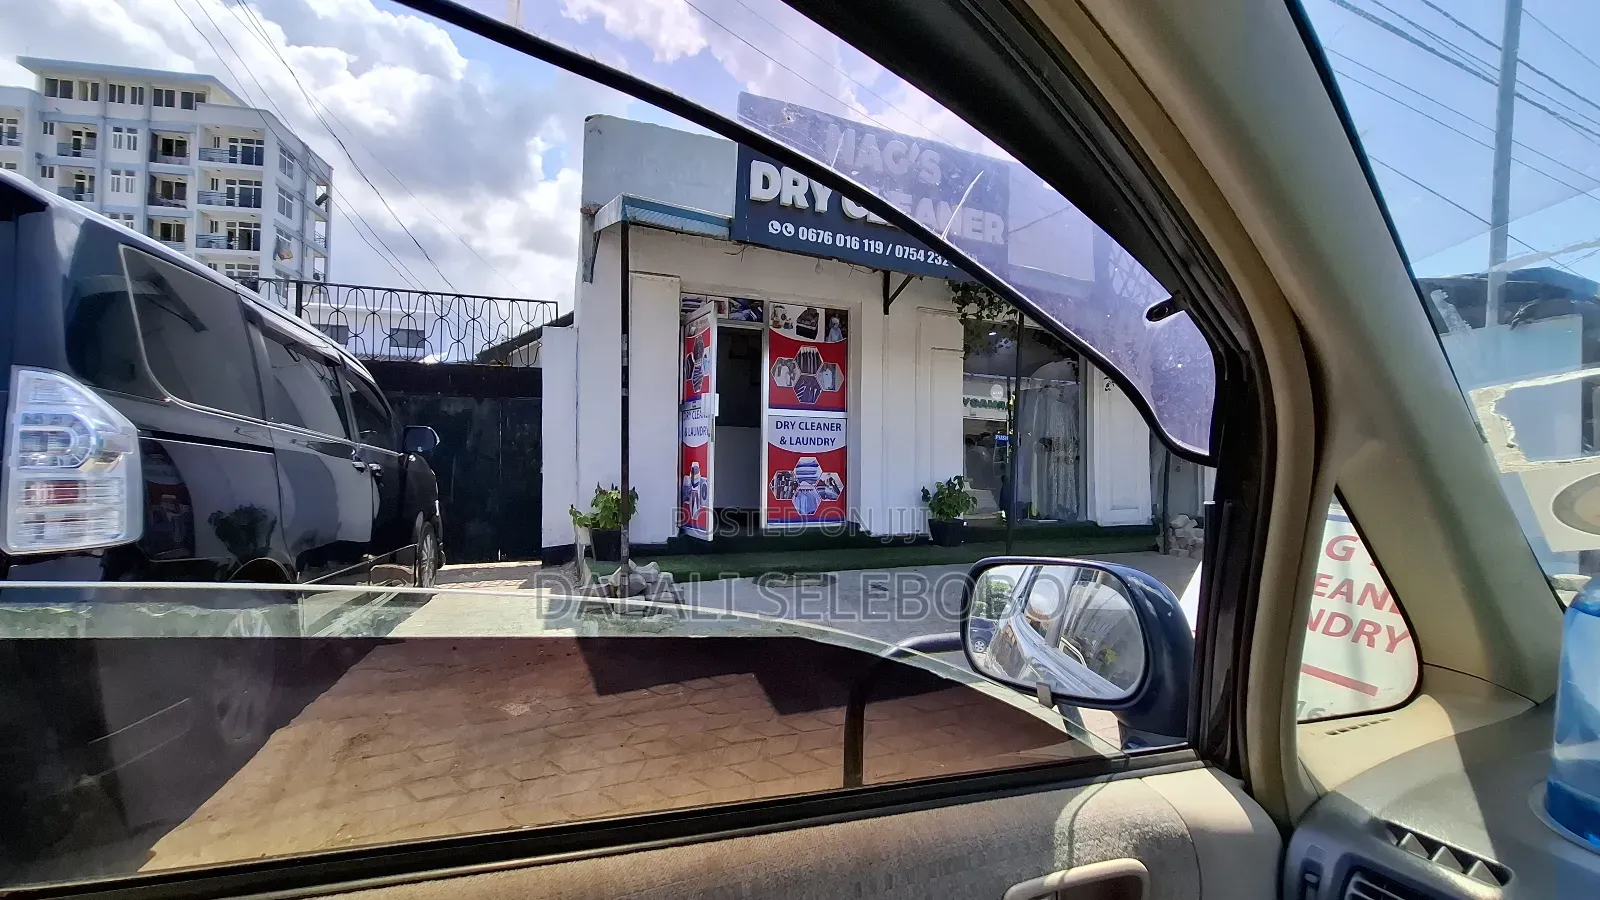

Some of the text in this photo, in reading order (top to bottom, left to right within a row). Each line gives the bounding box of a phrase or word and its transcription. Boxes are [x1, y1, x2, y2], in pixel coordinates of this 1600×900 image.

[750, 159, 833, 214] DRY
[798, 226, 833, 245] 0676
[835, 233, 860, 250] 016
[862, 238, 884, 254] 119
[885, 243, 893, 256] /
[894, 244, 925, 262] 0754
[775, 420, 842, 432] DRY CLEANER
[779, 435, 836, 447] & LAUNDRY
